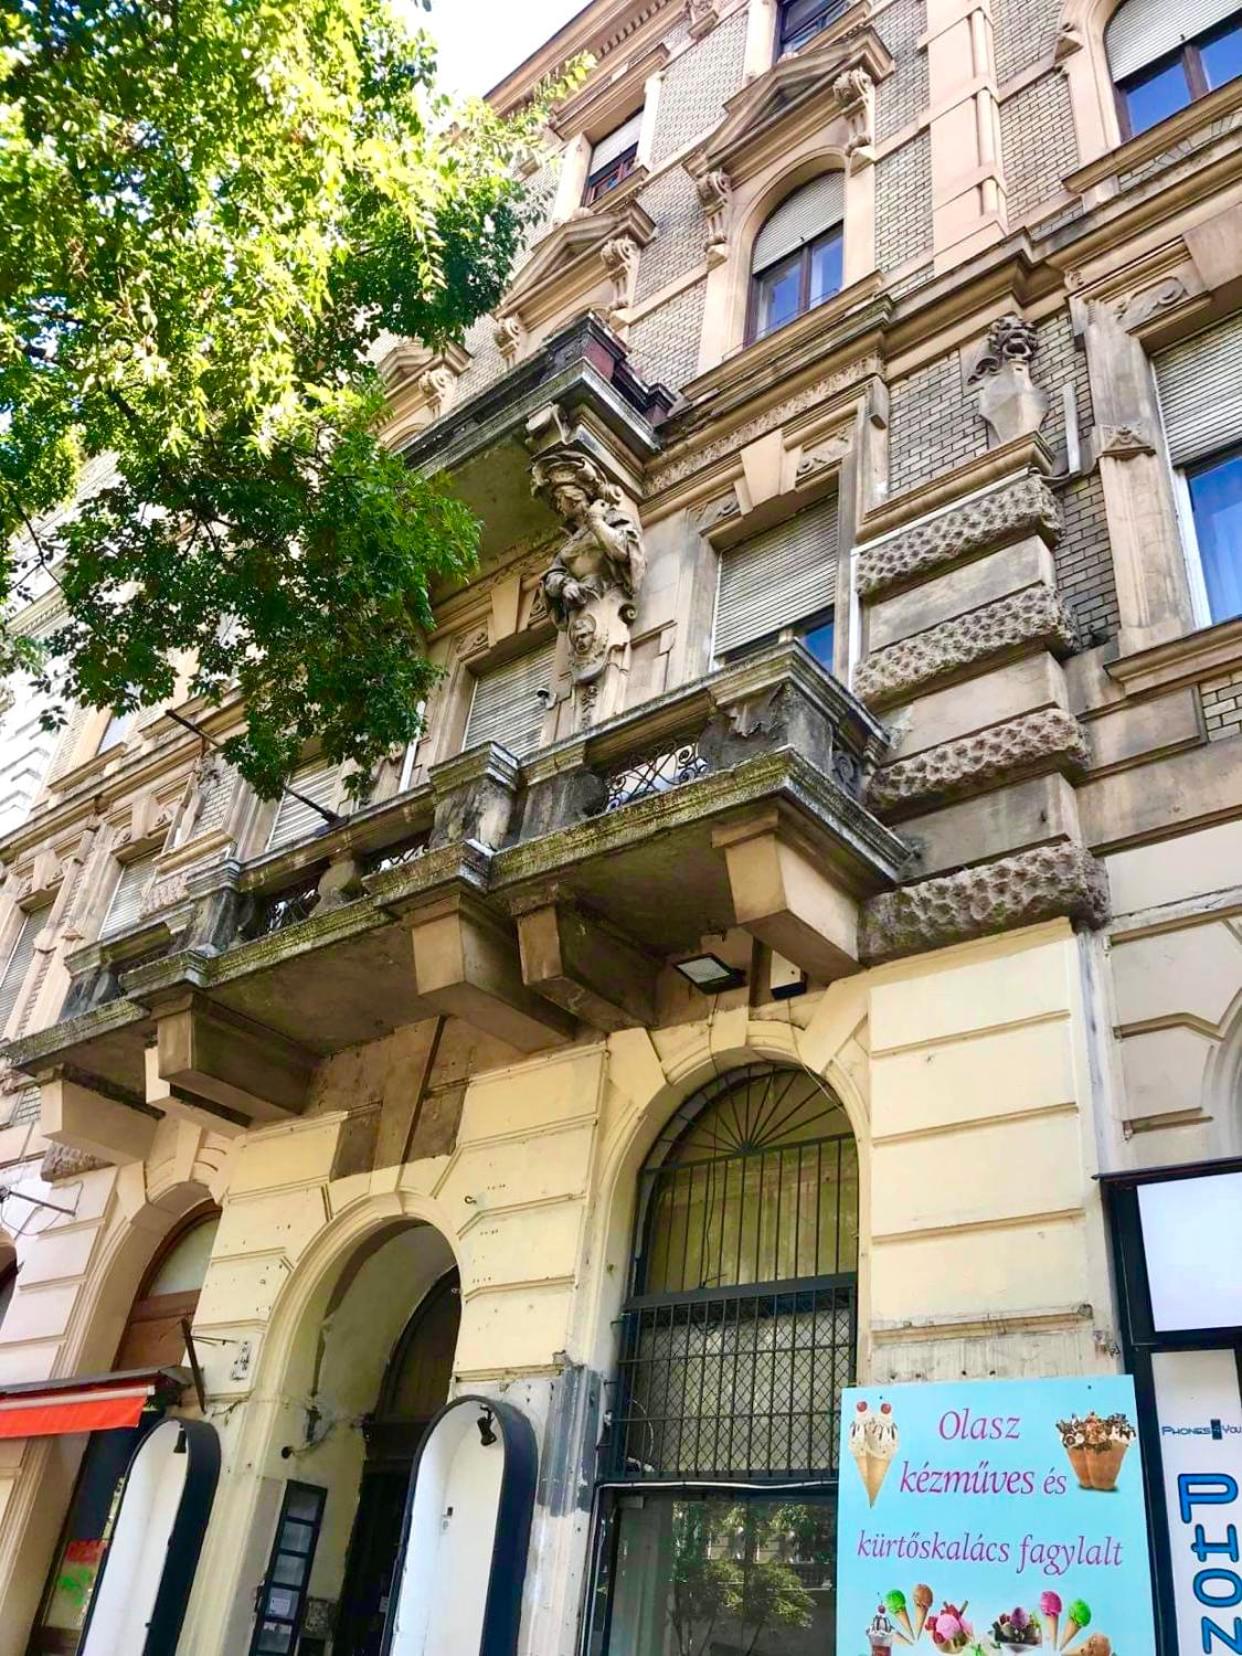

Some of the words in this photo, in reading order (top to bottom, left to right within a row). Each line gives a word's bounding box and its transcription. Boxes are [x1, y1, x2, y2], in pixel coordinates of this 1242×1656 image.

[938, 1408, 1021, 1441] Olasz
[900, 1461, 1035, 1495] kézműves
[1043, 1467, 1067, 1495] és
[857, 1530, 1010, 1563] kürtőskalács
[1016, 1534, 1123, 1576] fagylalt
